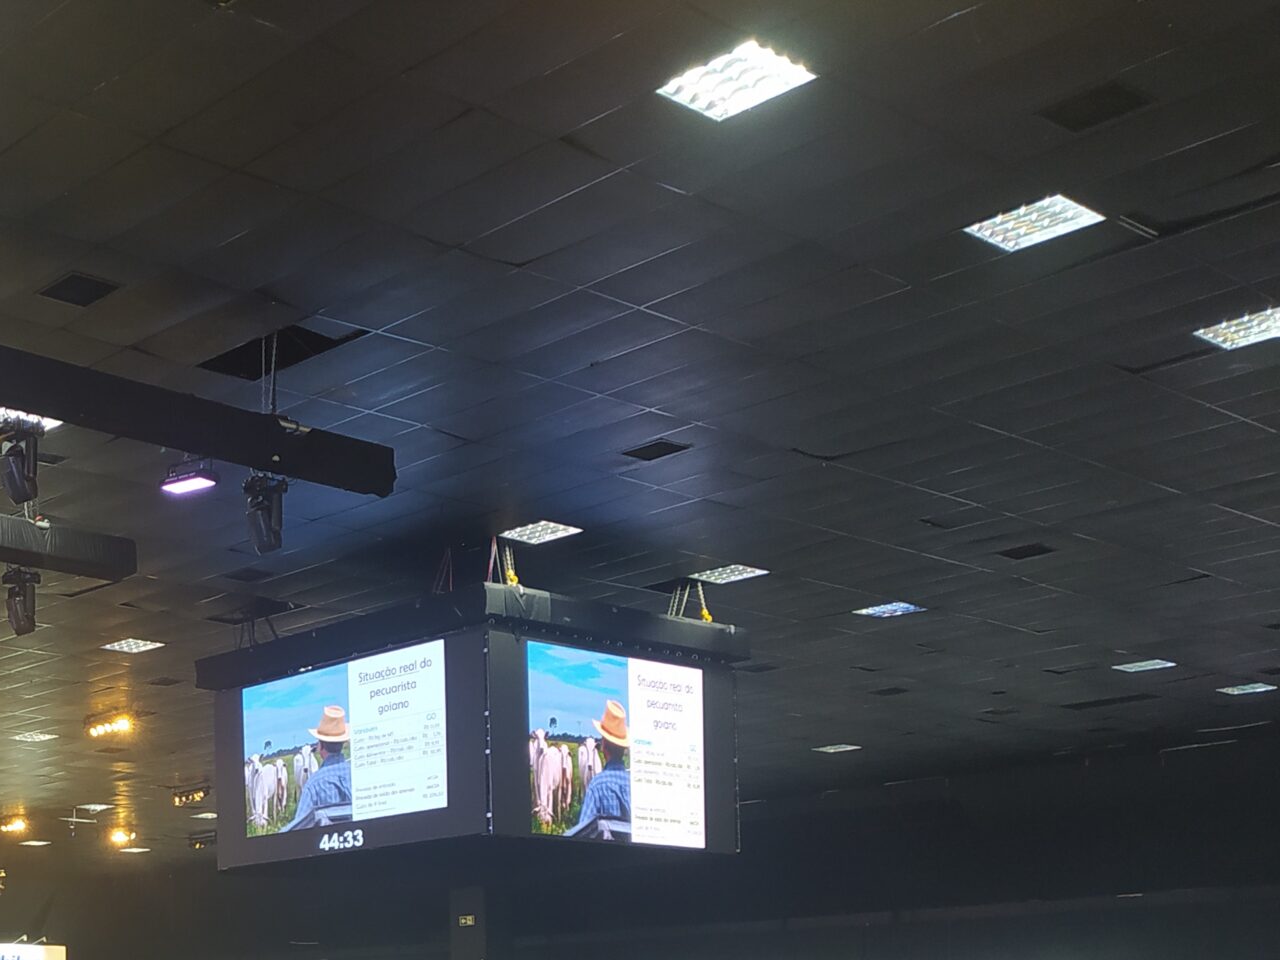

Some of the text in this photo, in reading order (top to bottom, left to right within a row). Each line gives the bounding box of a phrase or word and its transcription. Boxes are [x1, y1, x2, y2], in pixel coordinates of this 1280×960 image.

[358, 657, 432, 683] Situação real do
[369, 680, 417, 700] pecuarista
[378, 699, 410, 716] goiano
[319, 828, 364, 851] 44:33
